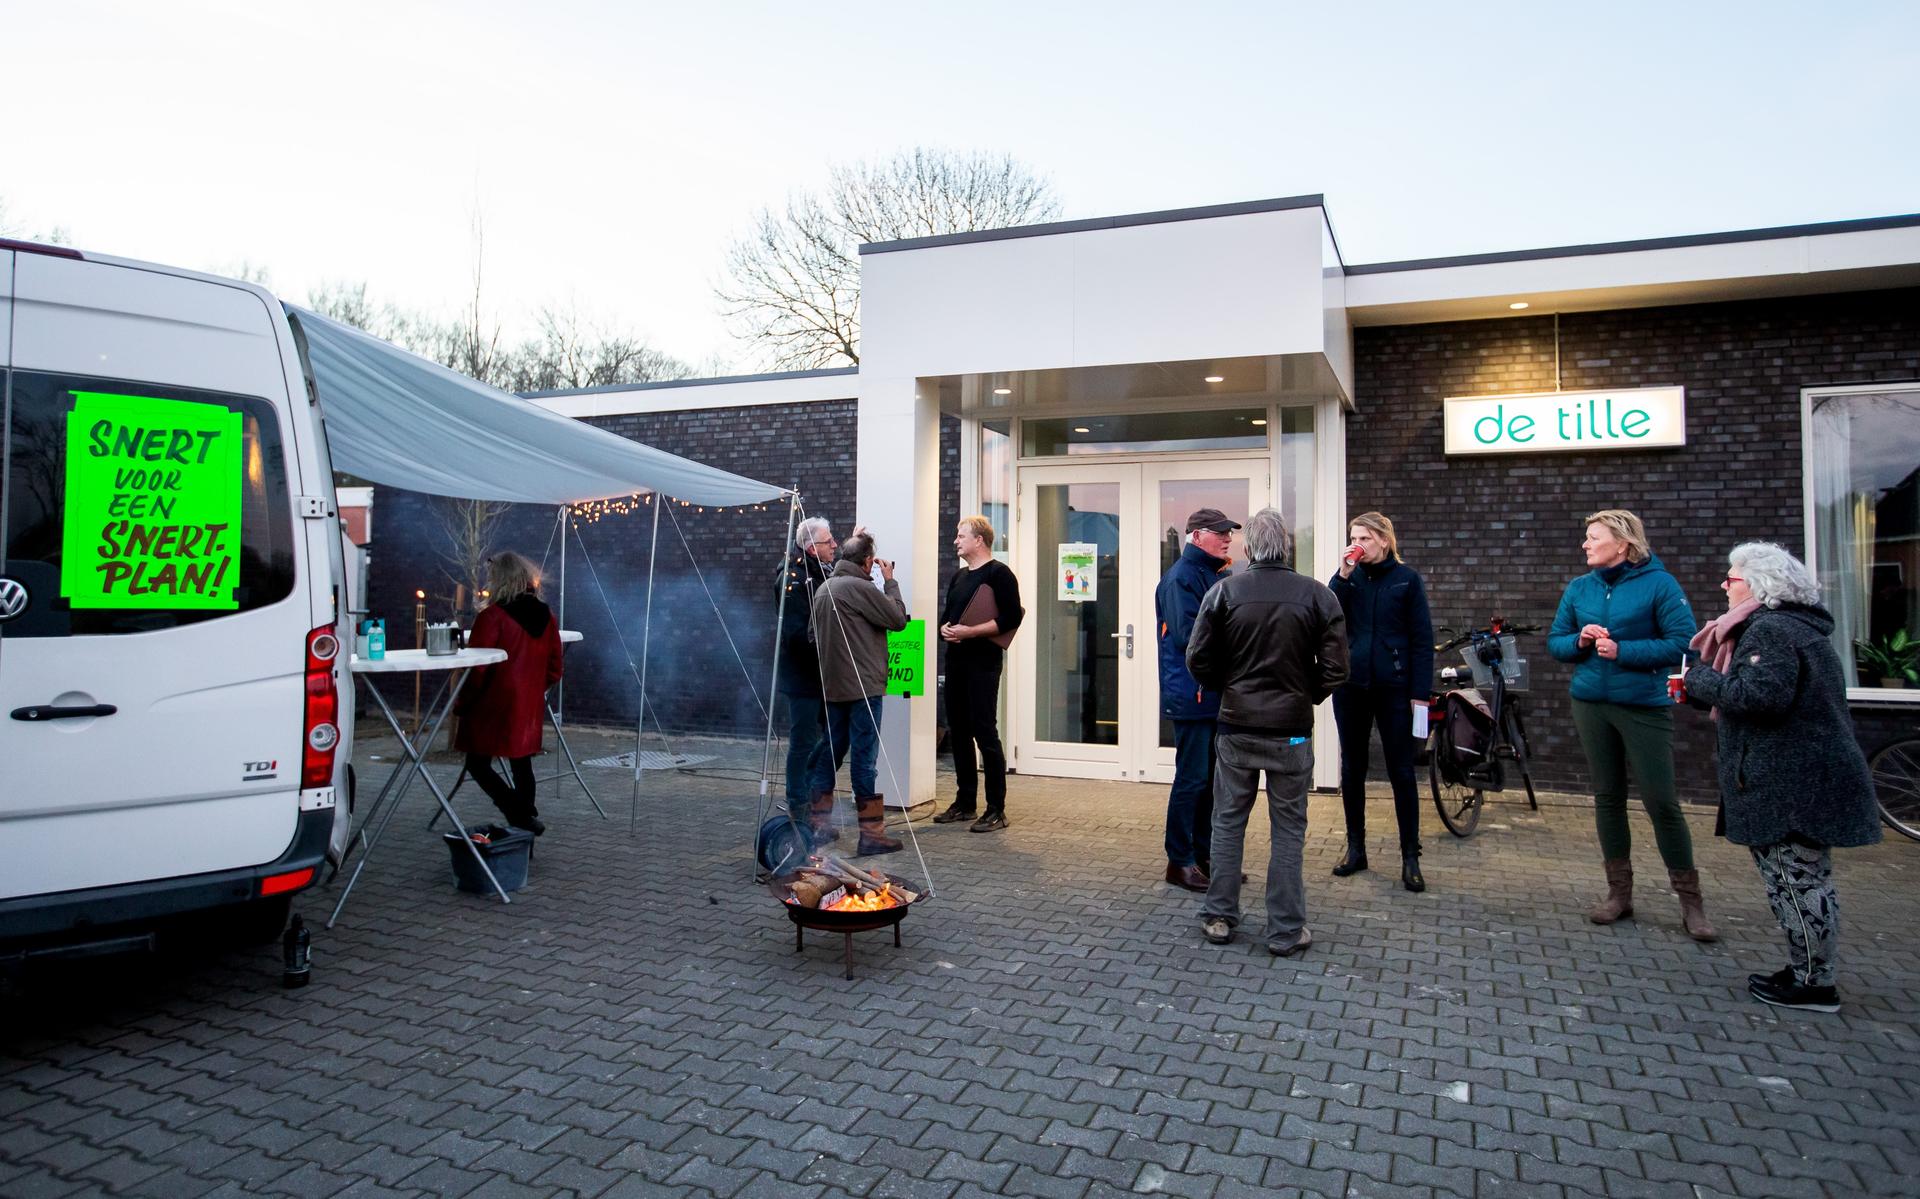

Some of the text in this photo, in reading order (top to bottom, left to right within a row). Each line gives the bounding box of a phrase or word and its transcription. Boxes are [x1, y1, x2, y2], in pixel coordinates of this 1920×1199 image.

[1474, 399, 1651, 444] de tille
[88, 419, 222, 465] SNERT
[114, 467, 183, 491] VOOR
[107, 493, 177, 519] EEN
[96, 556, 232, 598] PLAN!
[887, 667, 914, 682] AND
[242, 760, 277, 772] TDI
